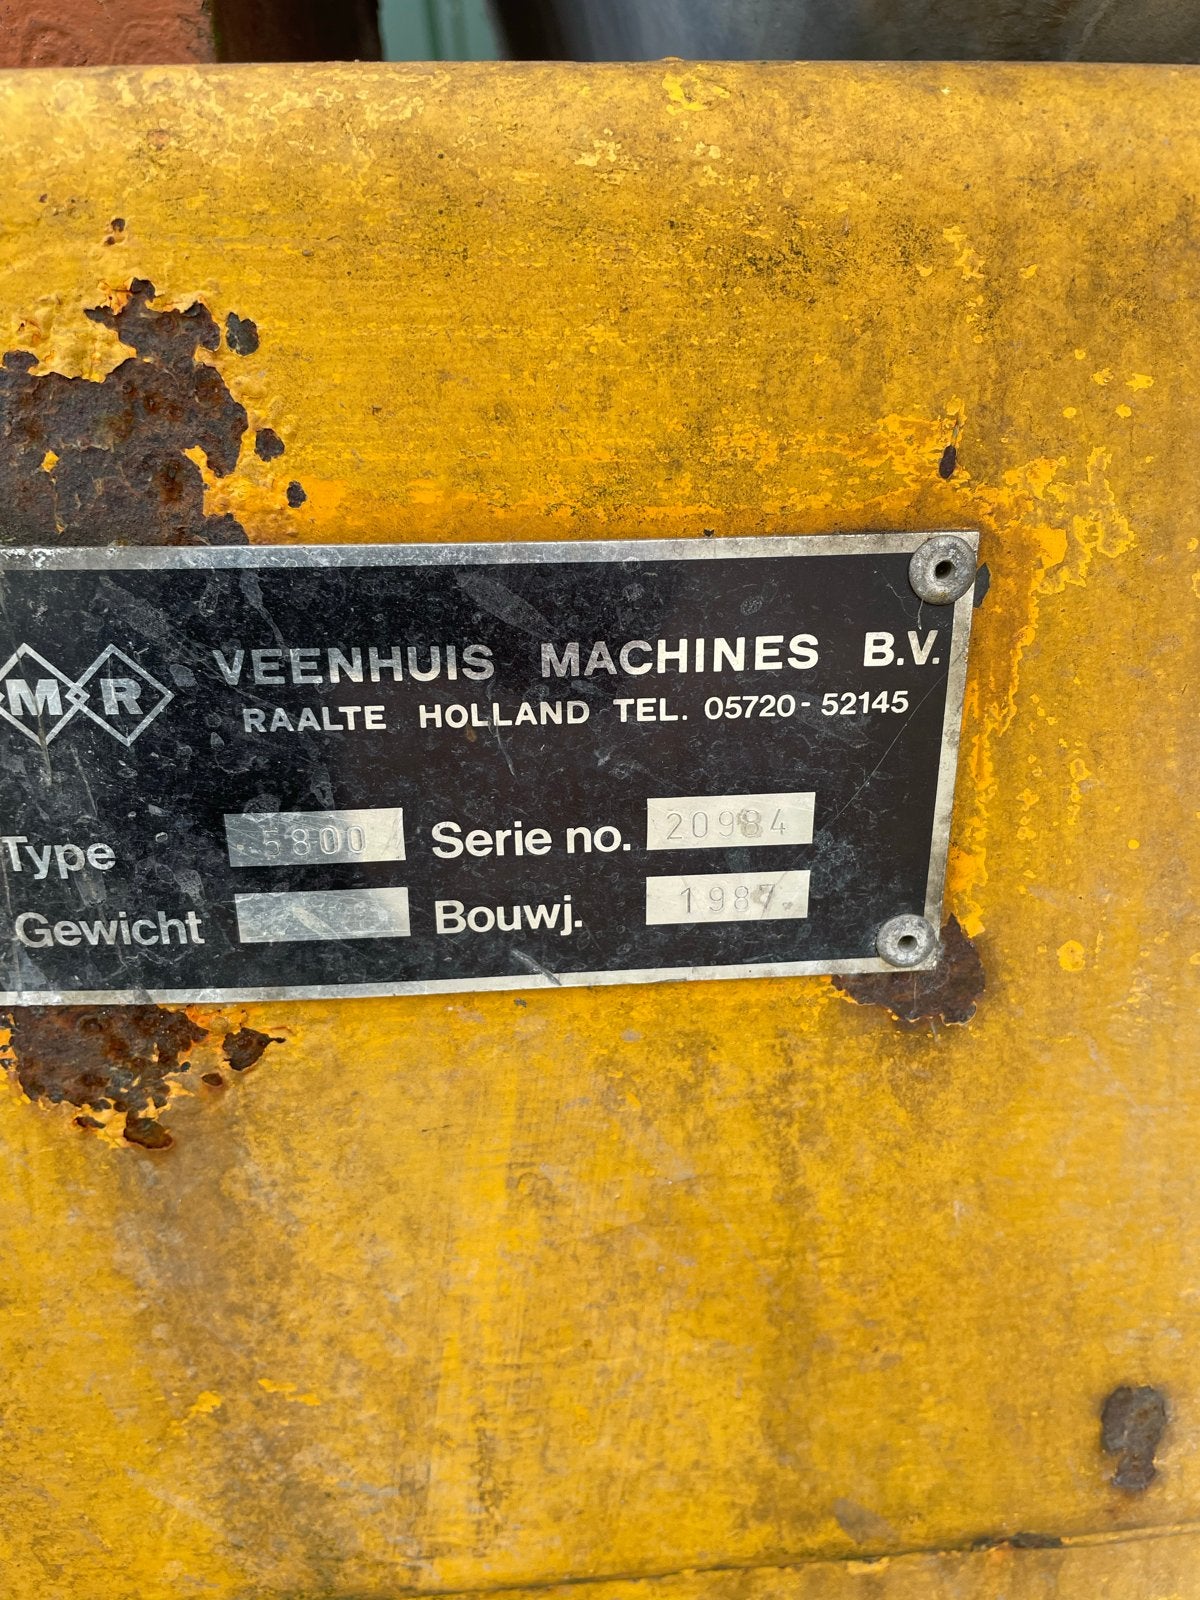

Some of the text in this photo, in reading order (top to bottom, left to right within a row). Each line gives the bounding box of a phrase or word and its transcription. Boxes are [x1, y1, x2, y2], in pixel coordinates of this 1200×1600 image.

[212, 629, 941, 686] VEENHUIS MACHINES B.V.
[243, 704, 387, 733] RAALTE
[418, 699, 591, 729] HOLLAND
[613, 697, 688, 723] TEL.
[261, 823, 368, 856] 5800
[431, 816, 631, 860] Serie no.
[665, 808, 787, 841] 20984
[1, 834, 117, 880] Type
[434, 894, 583, 937] Bouwj.
[680, 883, 776, 914] 1987
[14, 909, 205, 950] Gewicht
